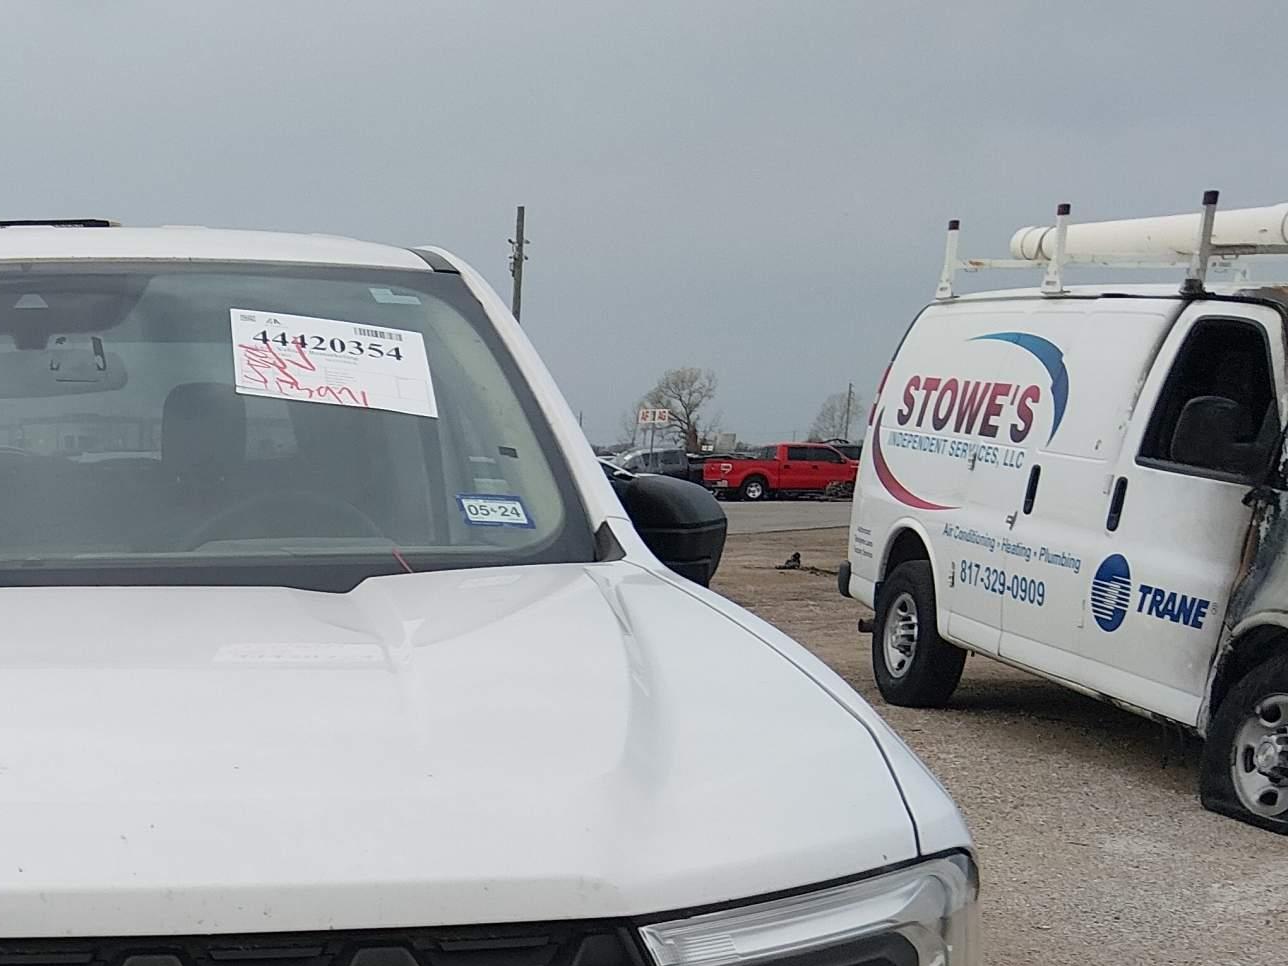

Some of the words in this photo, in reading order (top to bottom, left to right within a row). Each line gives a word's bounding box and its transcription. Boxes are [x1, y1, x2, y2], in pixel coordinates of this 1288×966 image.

[252, 329, 404, 362] 44420354
[897, 375, 1041, 443] STOWE'S
[888, 431, 948, 455] INDEPENDENT
[948, 440, 999, 467] SERVICES,
[1003, 448, 1025, 469] LLC
[942, 522, 954, 537] Air
[954, 525, 996, 553] Conditioning
[1000, 538, 1032, 562] Heating
[1038, 546, 1082, 574] Plumbing
[960, 559, 1045, 607] 817-329-0909
[1136, 584, 1210, 630] TRANE
